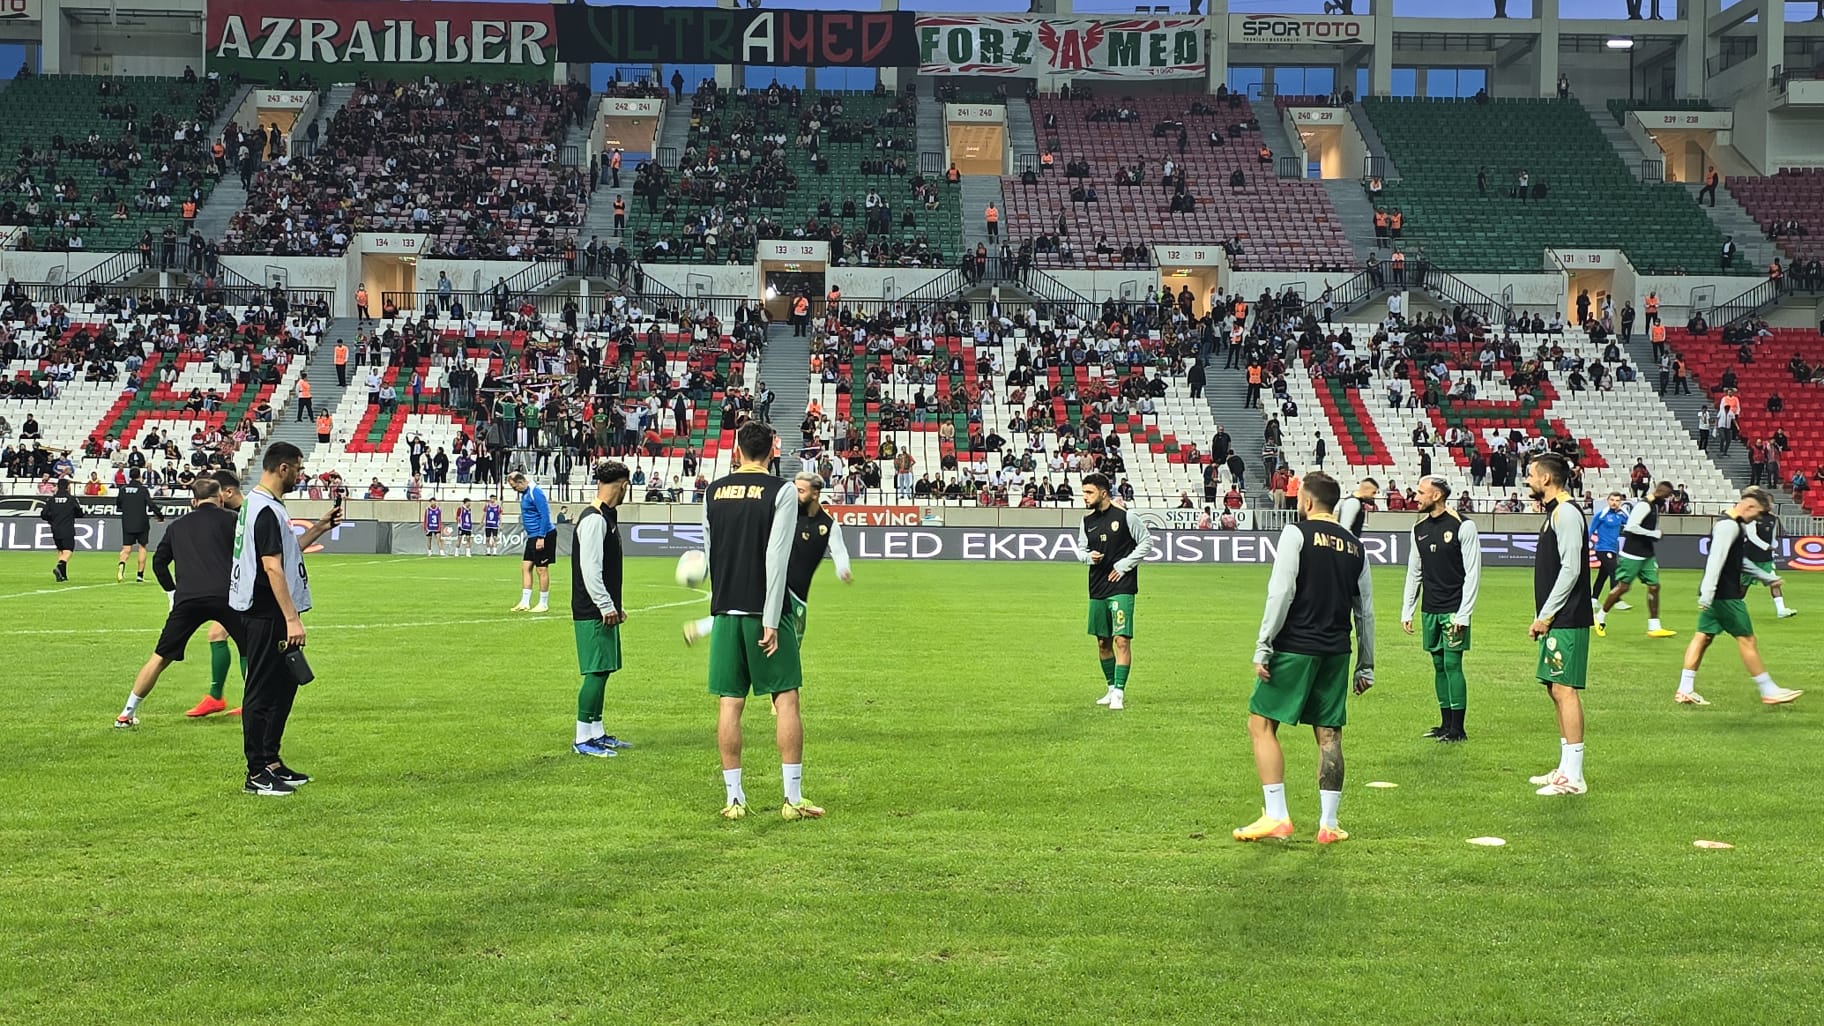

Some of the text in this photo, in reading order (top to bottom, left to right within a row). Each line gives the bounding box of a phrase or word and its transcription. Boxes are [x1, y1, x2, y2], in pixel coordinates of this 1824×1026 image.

[615, 102, 651, 111] 242 241
[957, 108, 993, 117] 241 240
[375, 238, 415, 248] 134 133
[775, 245, 814, 255] 133 132
[1167, 251, 1205, 260] 132 131
[1563, 254, 1601, 264] 131 130
[713, 485, 765, 501] AMED SK
[1166, 510, 1210, 522] SİSTE
[859, 531, 944, 559] LED
[962, 532, 1082, 560] EKRA
